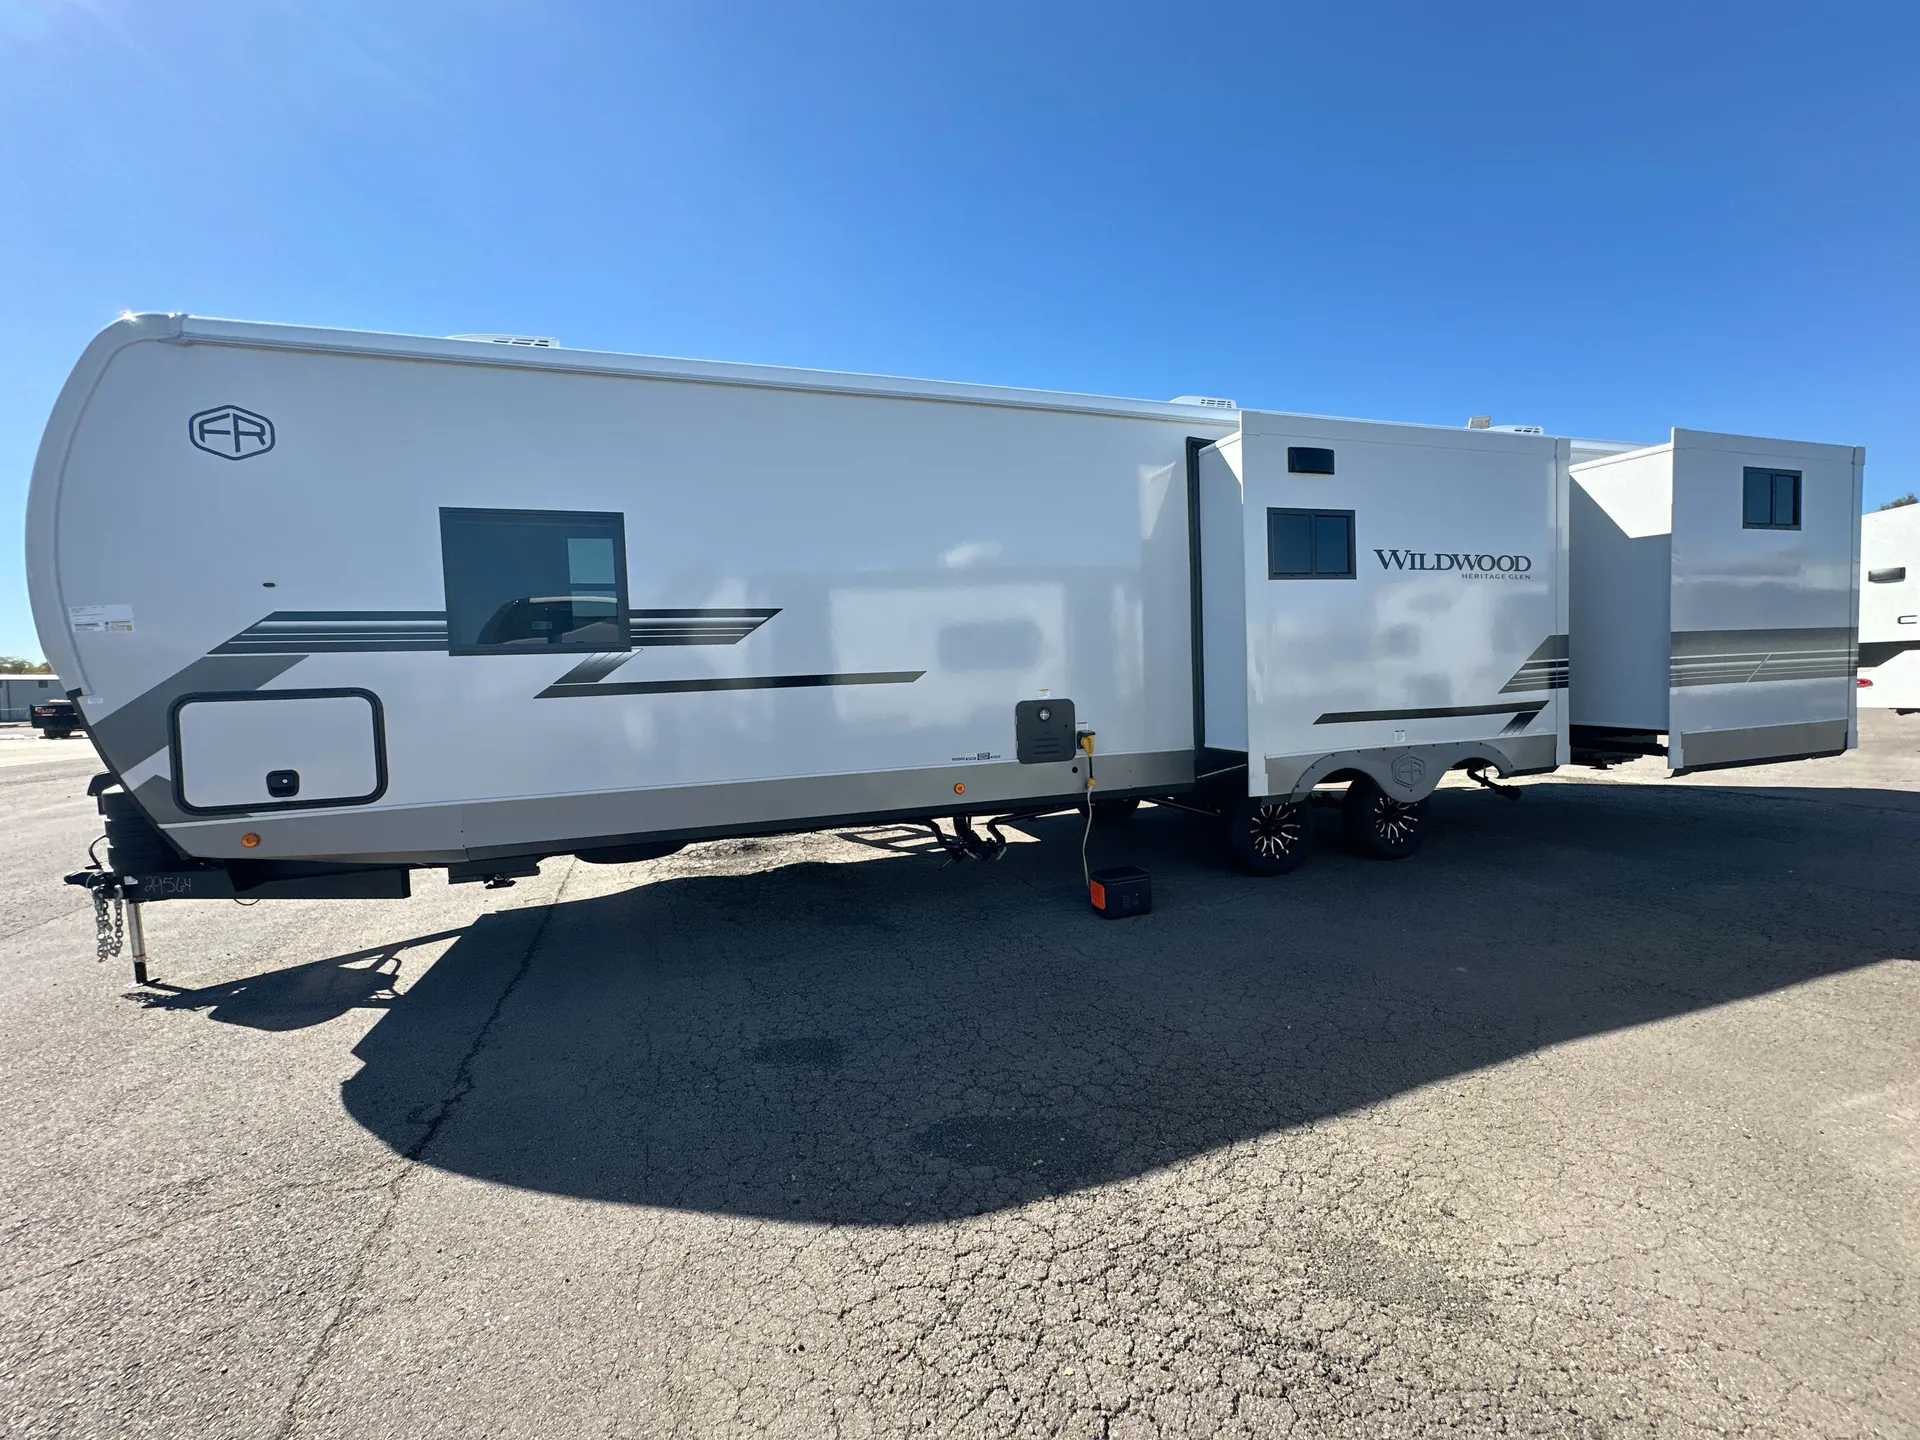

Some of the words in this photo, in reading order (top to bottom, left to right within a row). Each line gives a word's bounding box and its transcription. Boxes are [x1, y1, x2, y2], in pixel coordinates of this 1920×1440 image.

[198, 412, 267, 453] FR
[1373, 549, 1532, 572] WILDWOOD
[1461, 573, 1506, 581] HERITAGE
[144, 875, 192, 896] 29564
